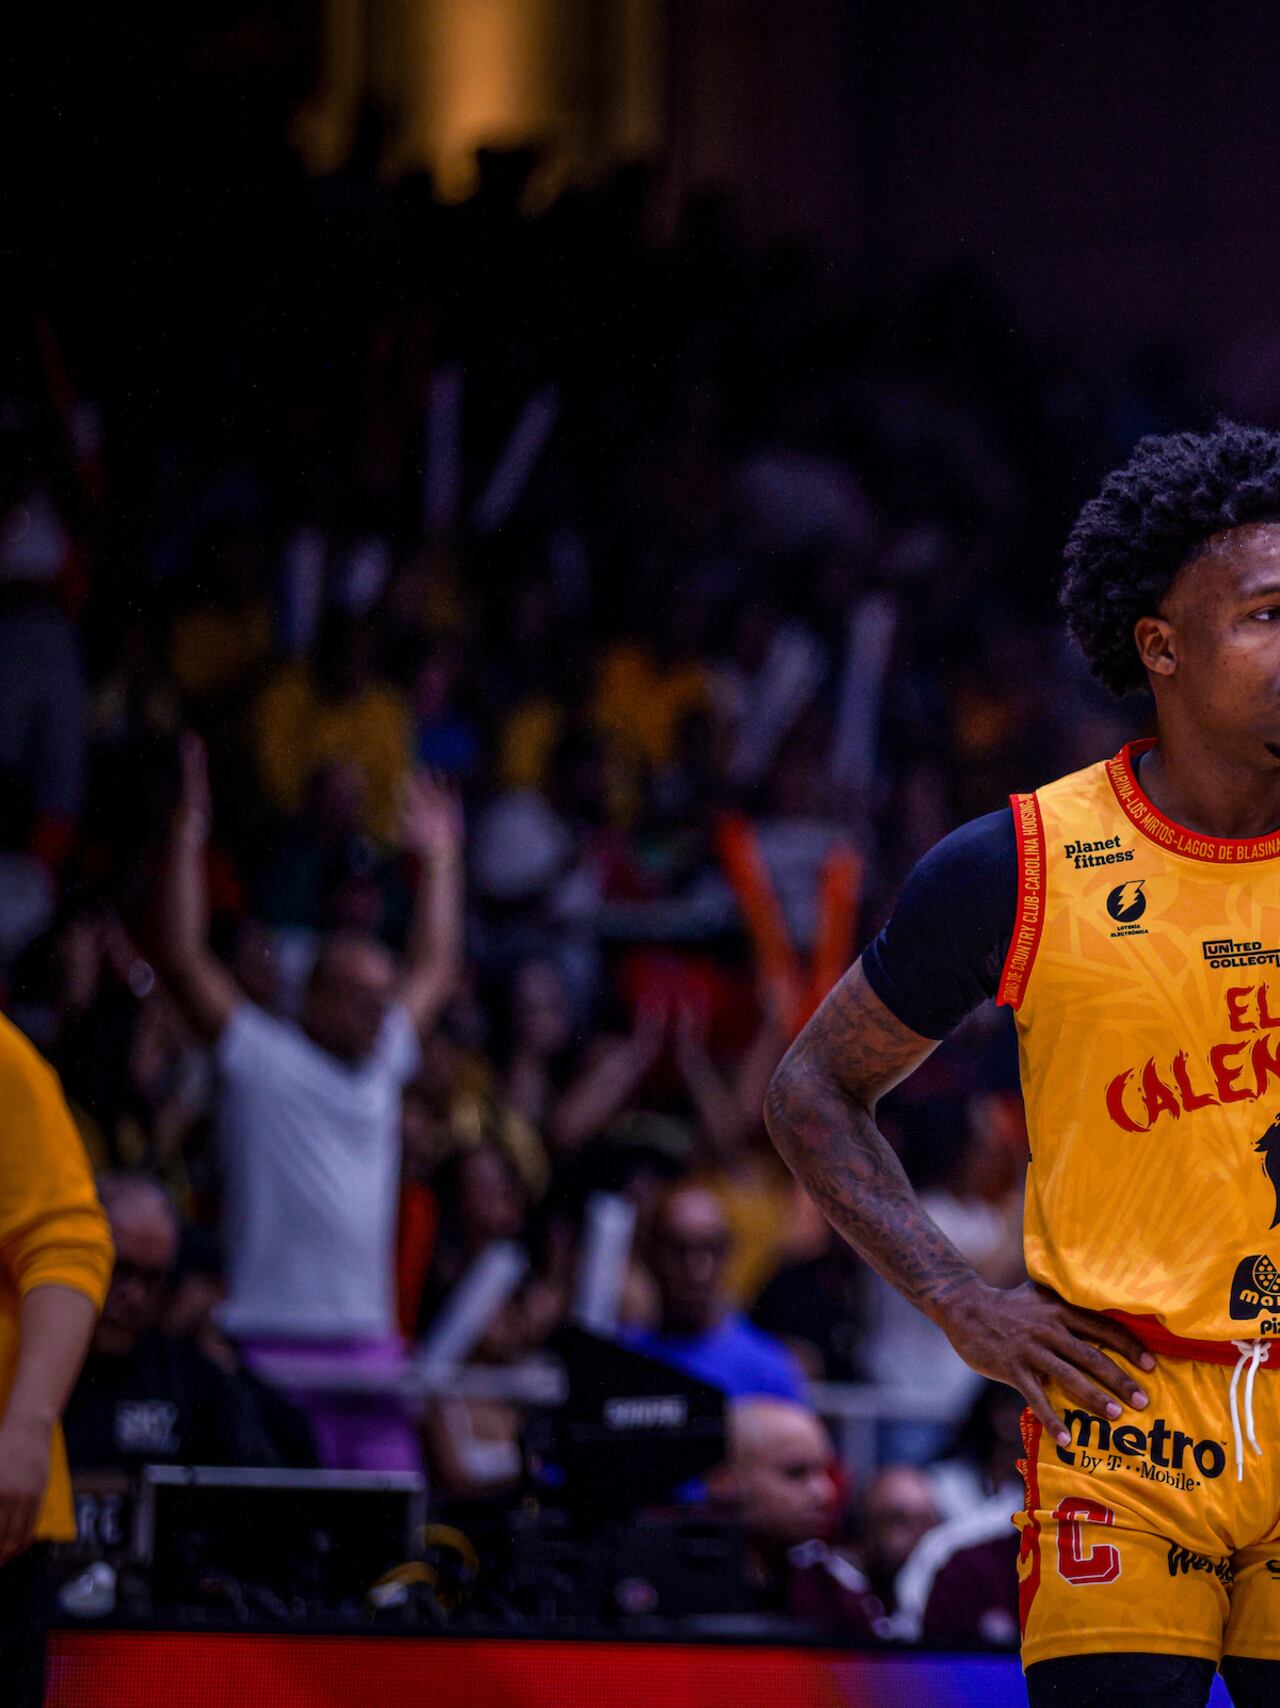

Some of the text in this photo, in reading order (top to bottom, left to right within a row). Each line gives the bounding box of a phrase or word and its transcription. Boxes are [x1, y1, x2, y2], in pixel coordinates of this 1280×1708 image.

[1064, 835, 1121, 859] planet
[1217, 845, 1233, 861] DE
[1073, 849, 1135, 870] fitness
[1009, 924, 1036, 972] COUNTRY
[1206, 940, 1262, 955] UNITED
[1056, 1408, 1226, 1479] metro
[1080, 1450, 1102, 1474] by
